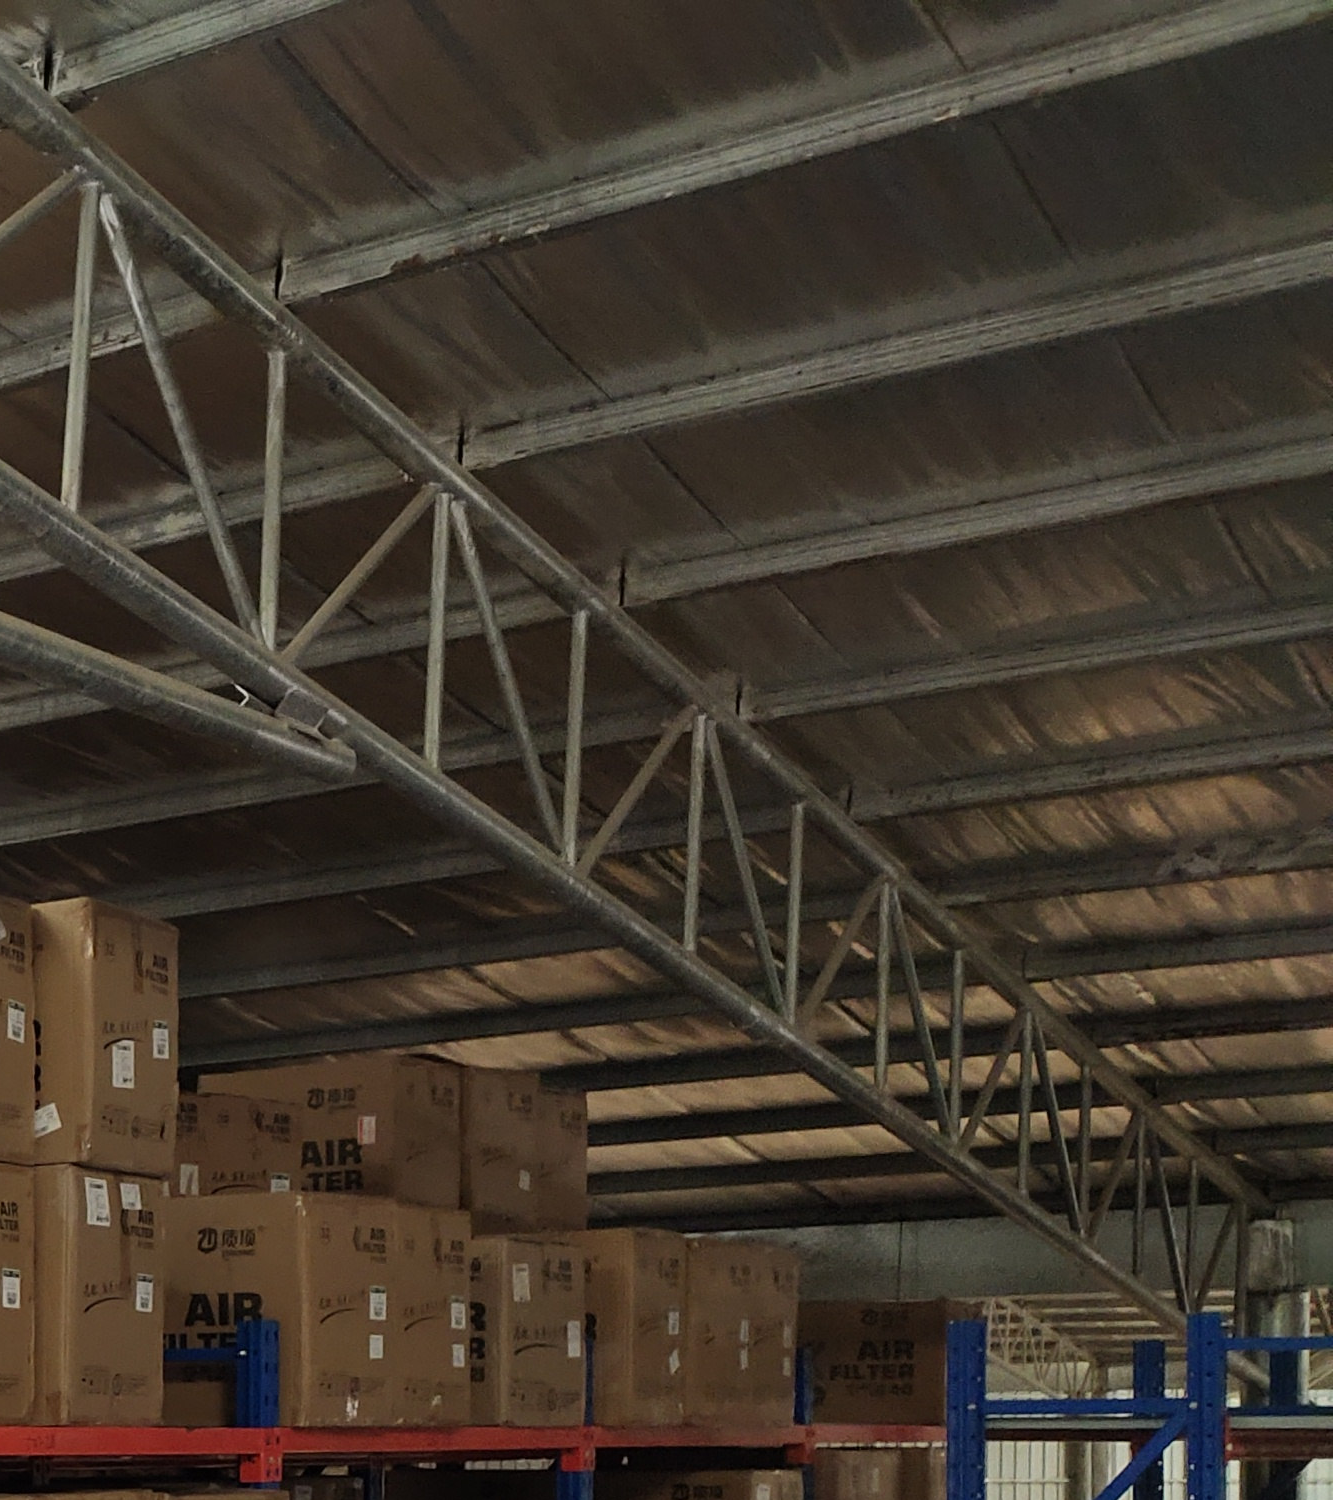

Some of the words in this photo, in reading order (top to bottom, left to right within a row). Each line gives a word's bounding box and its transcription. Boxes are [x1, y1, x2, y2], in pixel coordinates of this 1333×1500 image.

[9, 930, 25, 946] AIR
[152, 954, 168, 972] AIR
[145, 967, 169, 985] FILTER
[301, 1138, 363, 1168] AIR
[0, 1202, 18, 1219] AIR
[138, 1209, 154, 1225] AIR
[370, 1227, 386, 1241] AIR
[185, 1292, 263, 1327] AIR
[857, 1340, 915, 1361] AIR
[829, 1363, 915, 1382] FILTER
